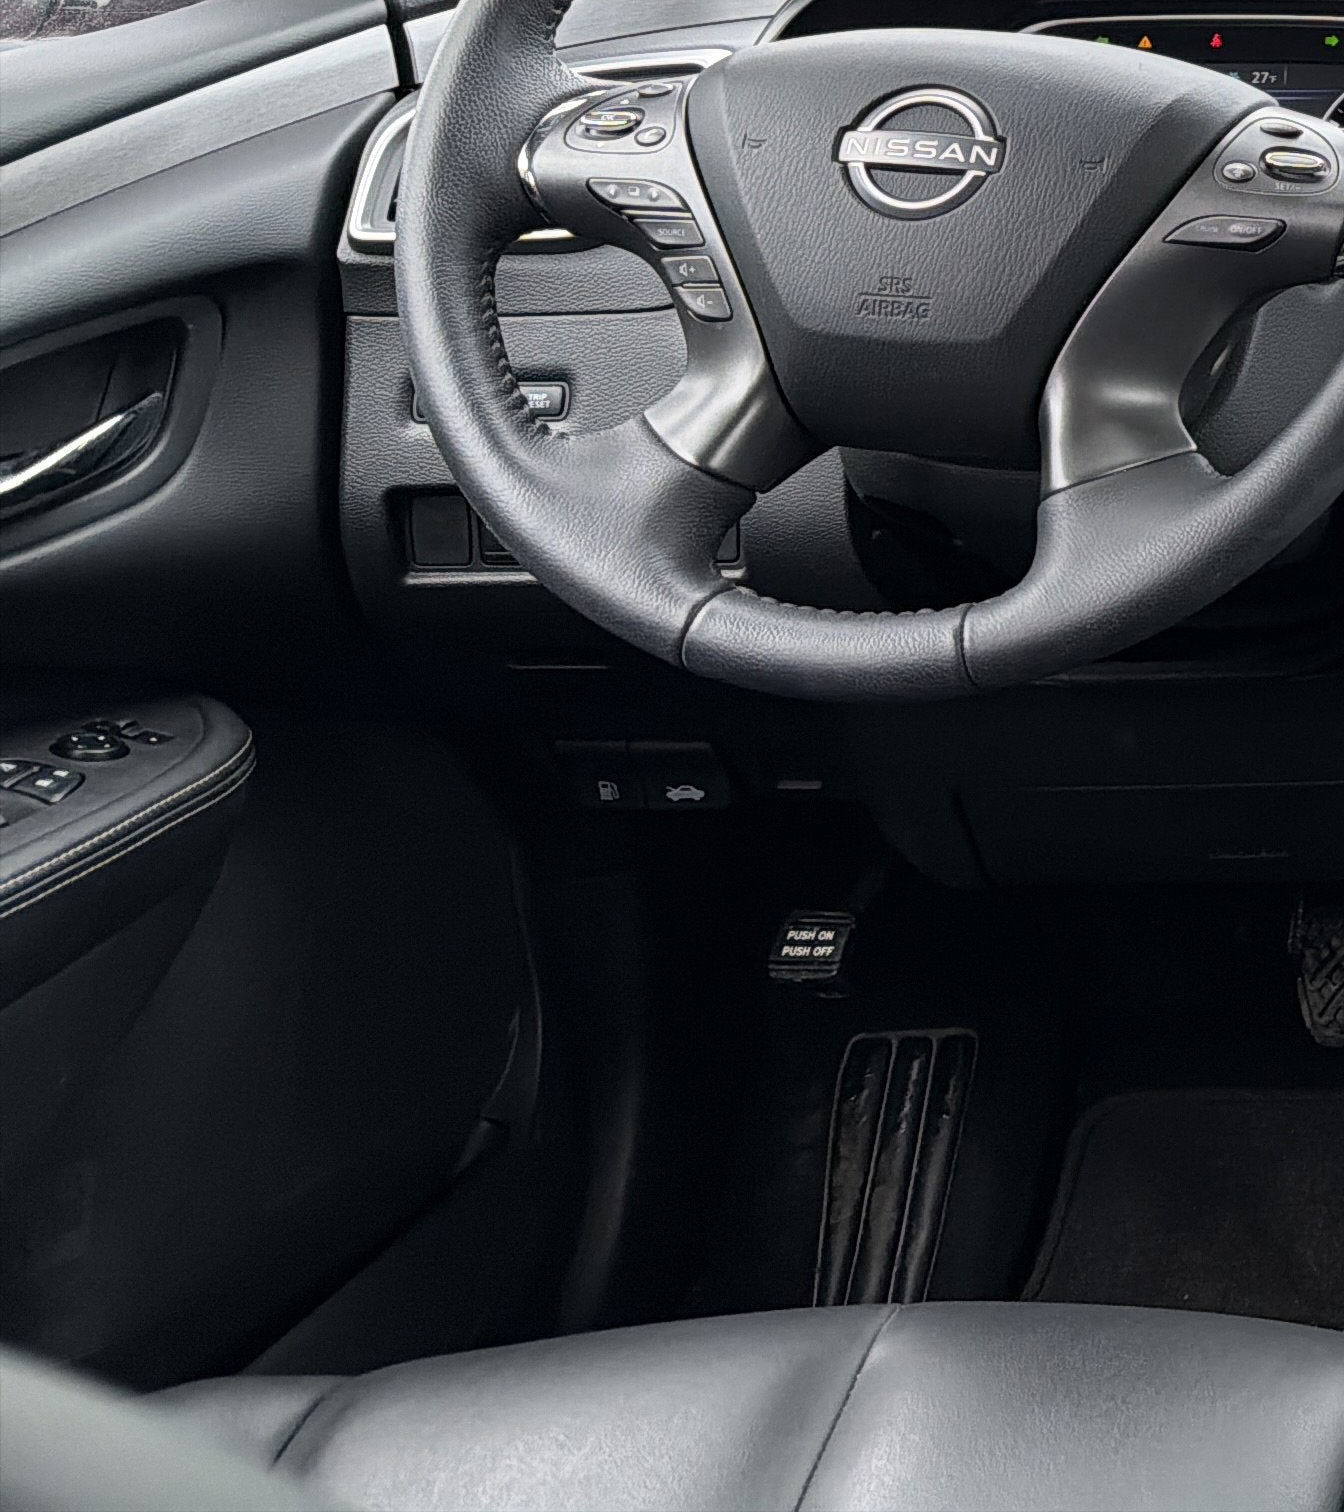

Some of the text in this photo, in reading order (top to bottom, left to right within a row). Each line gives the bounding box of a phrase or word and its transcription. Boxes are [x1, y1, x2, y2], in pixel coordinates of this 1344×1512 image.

[845, 137, 998, 166] NISSAN
[657, 228, 685, 237] SOURCE
[878, 276, 912, 294] SRS
[856, 300, 931, 320] AIRBAG
[786, 930, 836, 941] PUSH ON
[781, 946, 835, 957] PUSH OFF
